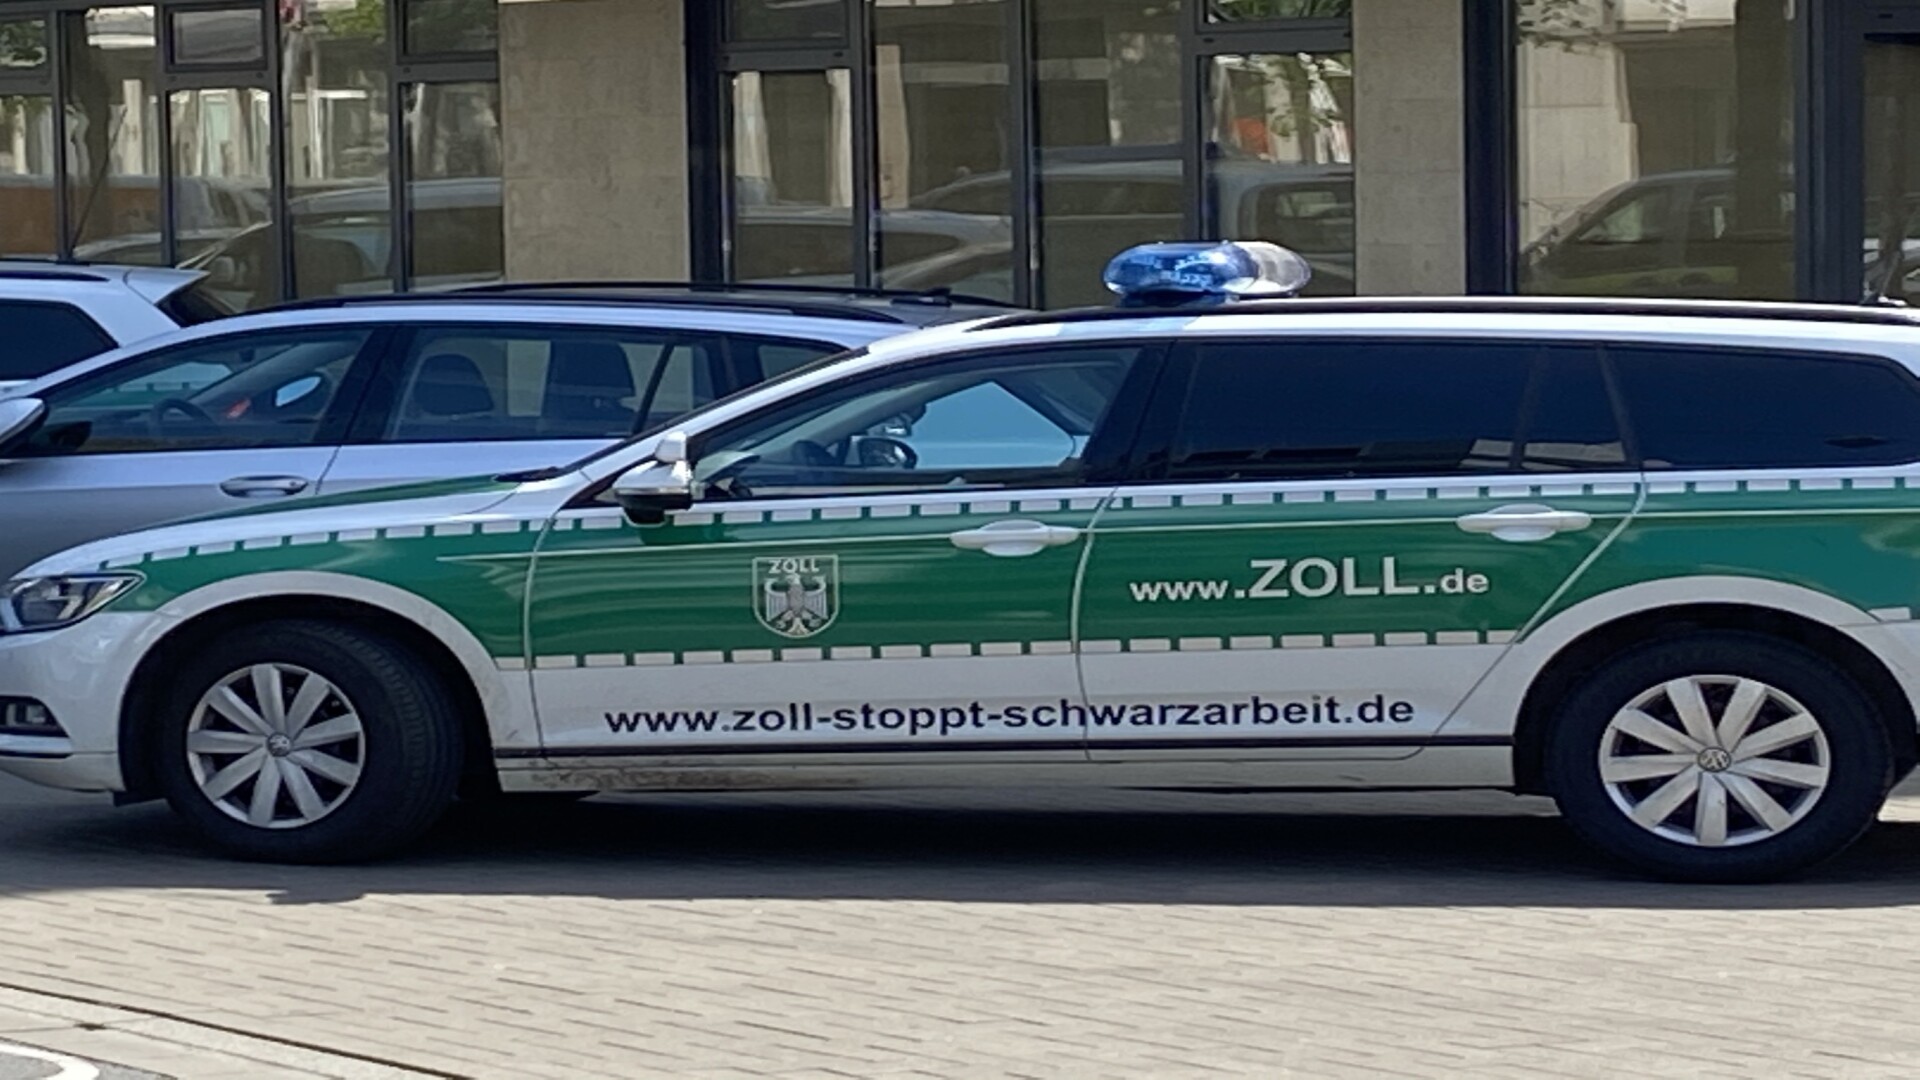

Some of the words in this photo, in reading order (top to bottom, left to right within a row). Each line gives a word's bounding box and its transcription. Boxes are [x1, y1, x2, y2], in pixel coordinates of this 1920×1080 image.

[768, 558, 819, 574] ZOLL
[1130, 556, 1489, 602] www.ZOLL.de
[604, 695, 1414, 735] www.zoll-stoppt-schwarzarbeit.de
